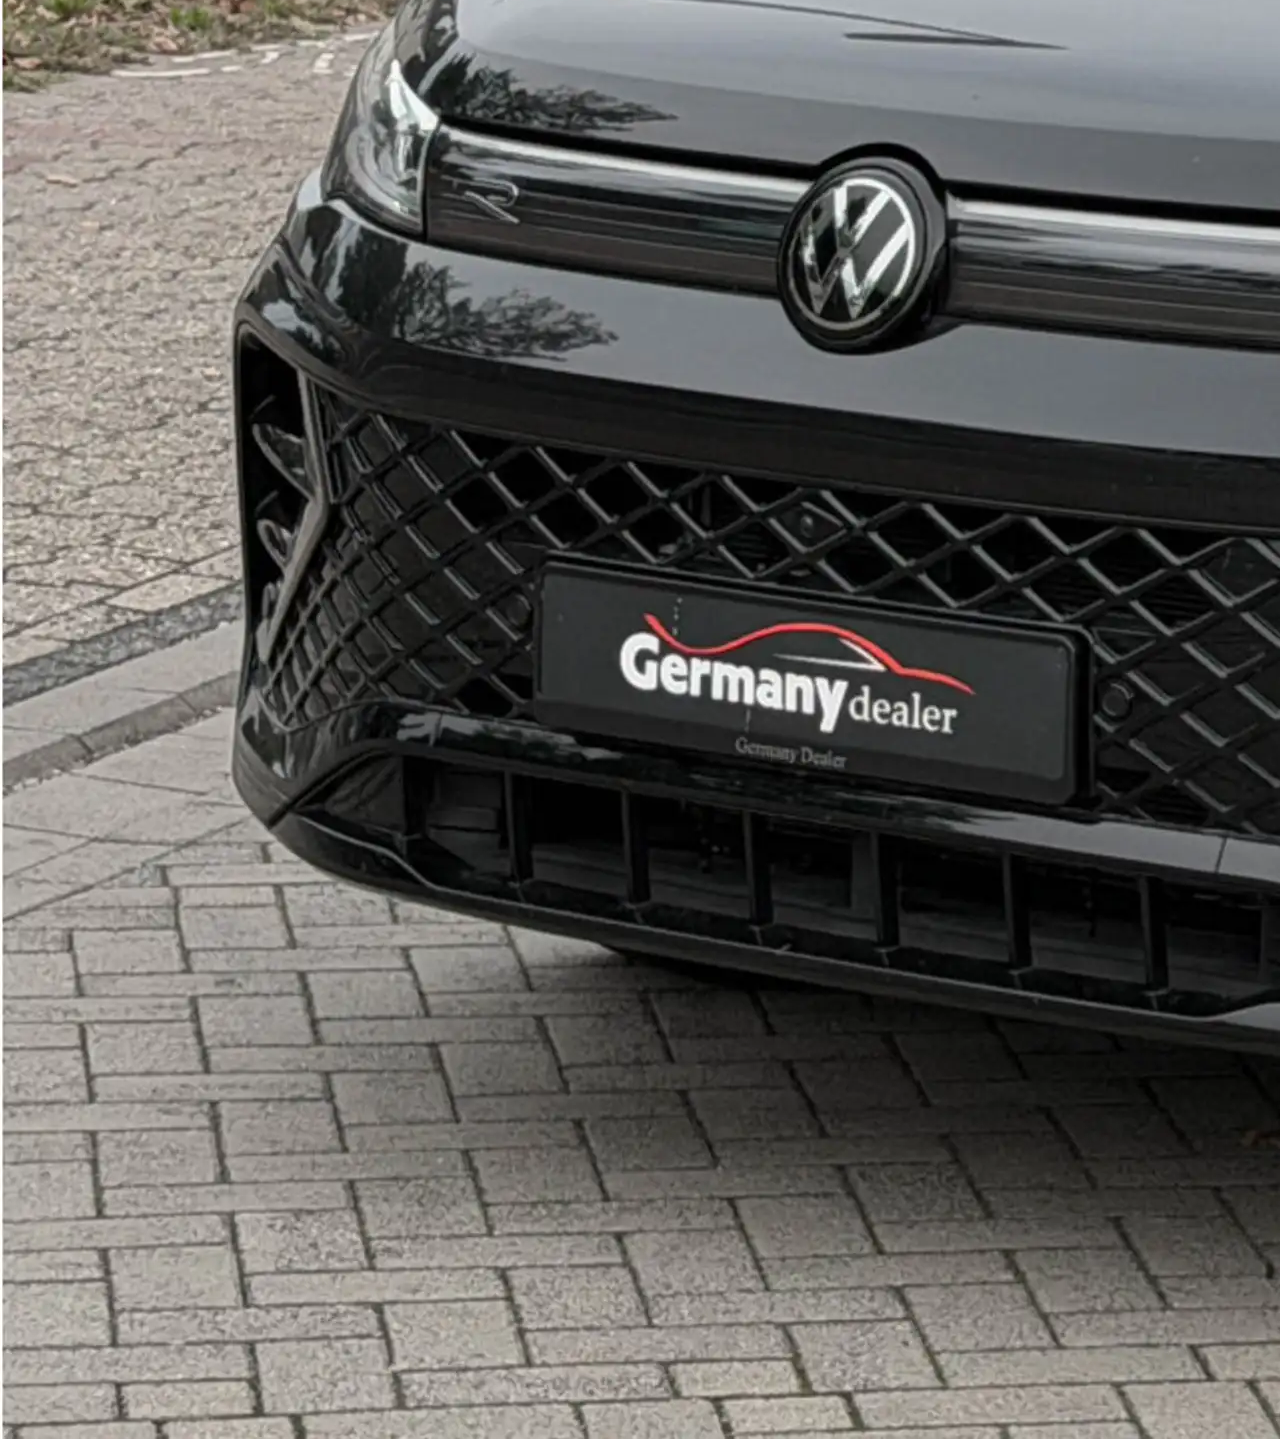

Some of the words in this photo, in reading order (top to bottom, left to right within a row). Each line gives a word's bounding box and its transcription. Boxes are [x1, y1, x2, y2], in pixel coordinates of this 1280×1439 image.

[619, 631, 848, 733] Germany
[848, 685, 958, 735] dealer
[735, 736, 798, 764] Germany
[801, 746, 847, 769] Dealer
